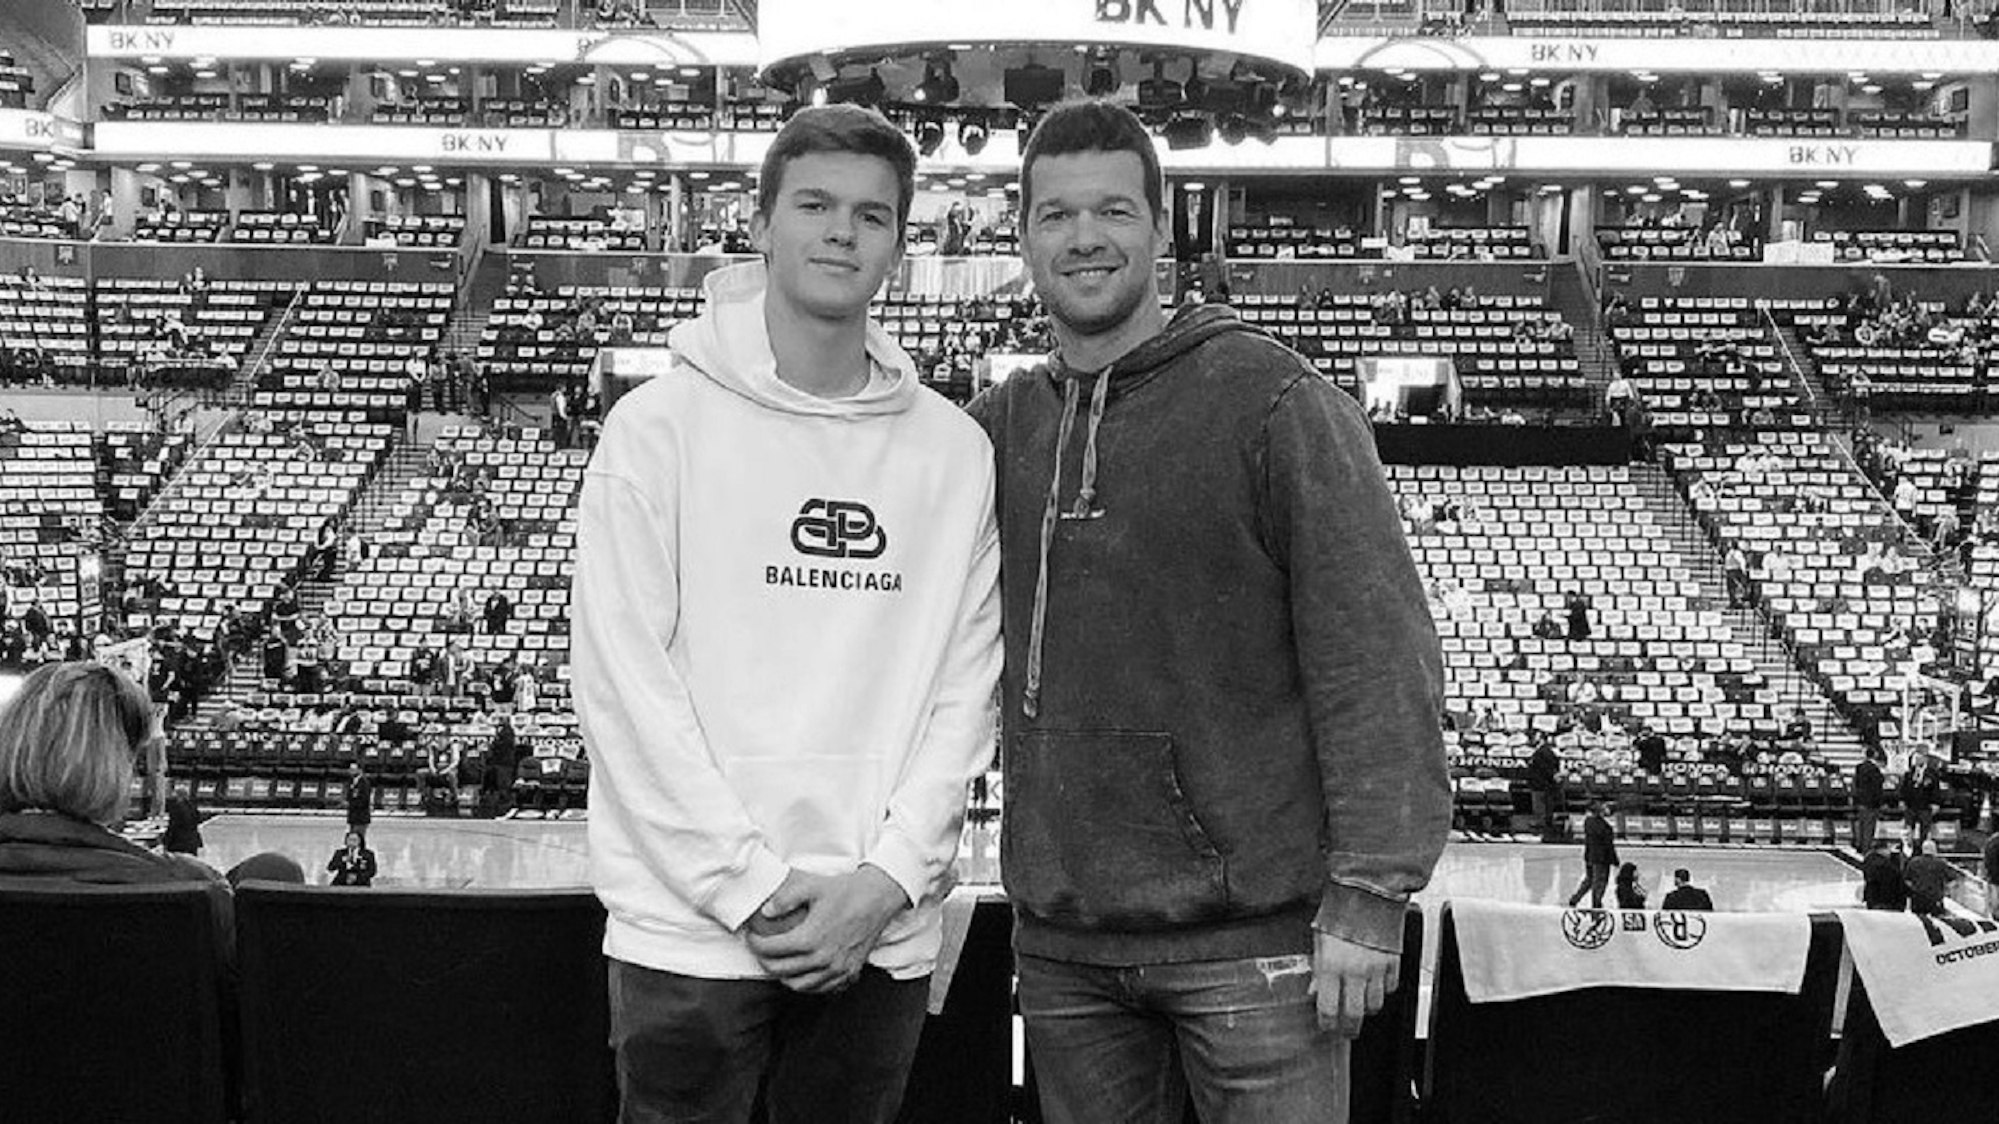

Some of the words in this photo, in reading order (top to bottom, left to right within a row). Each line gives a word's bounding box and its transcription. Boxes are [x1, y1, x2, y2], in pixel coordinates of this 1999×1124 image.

[109, 31, 137, 49] BK
[145, 31, 175, 49] NY
[1532, 44, 1560, 61] BK
[1568, 44, 1598, 62] NY
[25, 118, 54, 138] BK
[442, 133, 471, 151] BK
[478, 135, 509, 151] NY
[1789, 146, 1820, 163] BK
[1826, 146, 1859, 164] NY
[765, 565, 902, 591] BALENCIAGA
